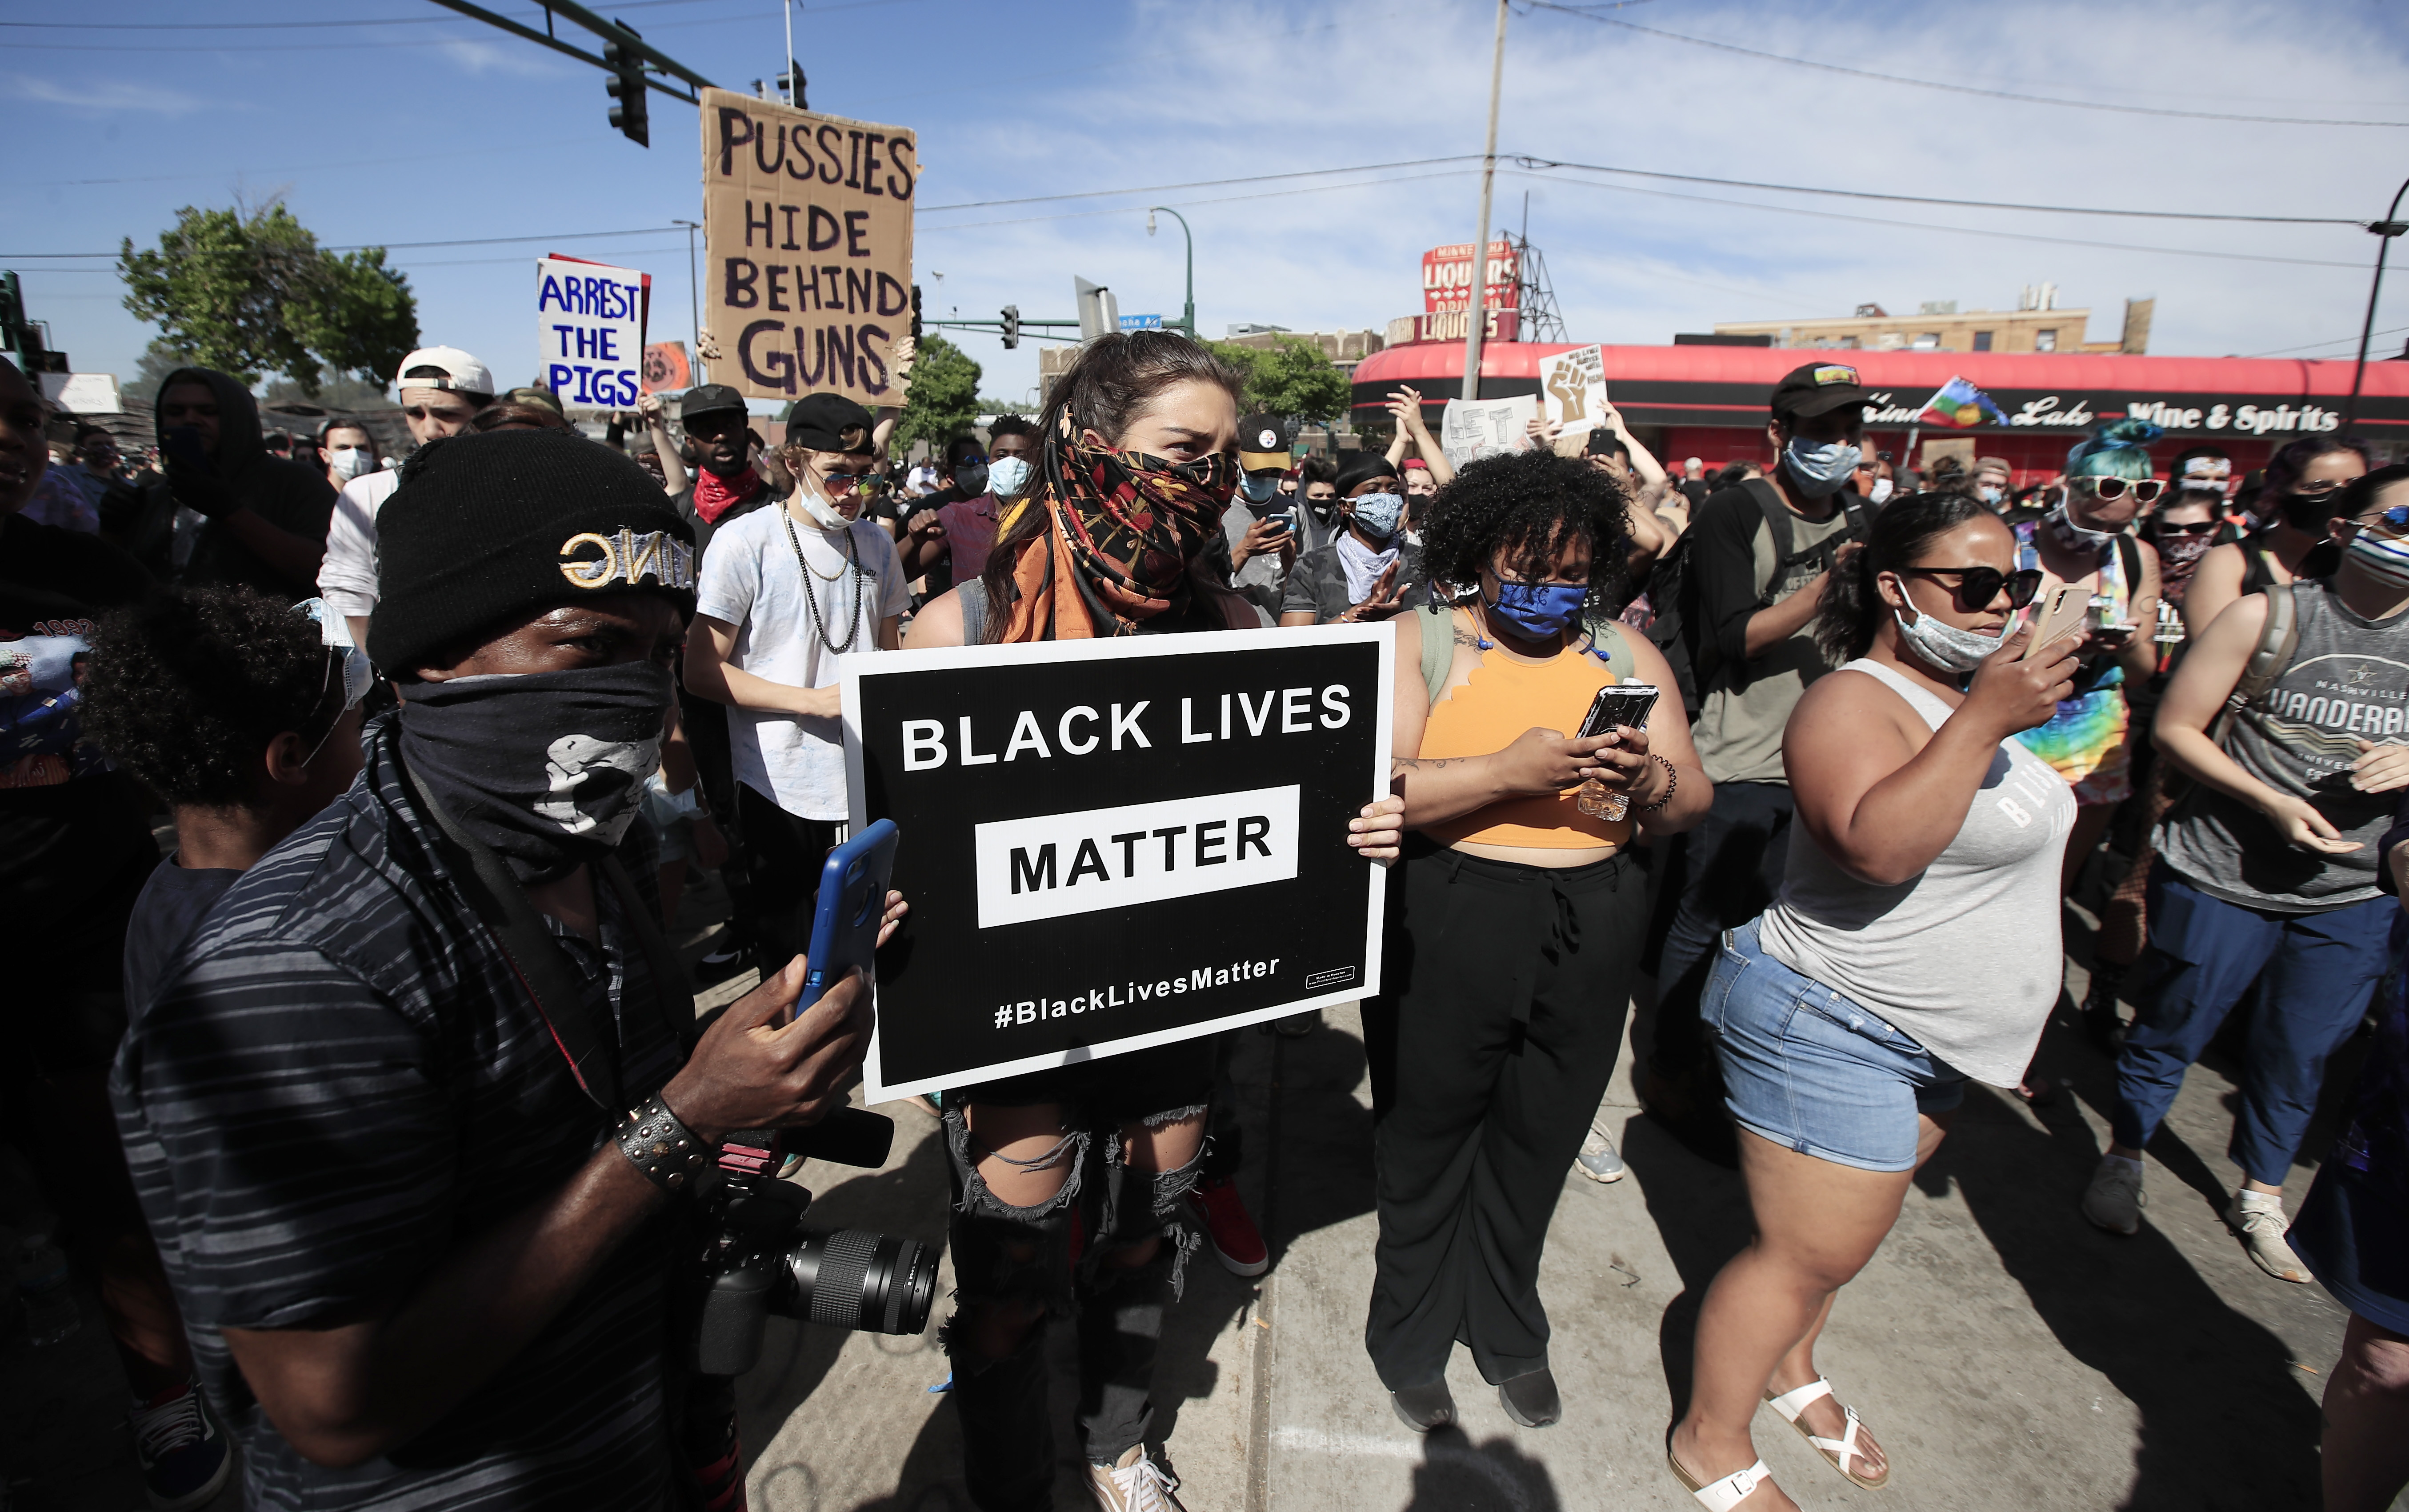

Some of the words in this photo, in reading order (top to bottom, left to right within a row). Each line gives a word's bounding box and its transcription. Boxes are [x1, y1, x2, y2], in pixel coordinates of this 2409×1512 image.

[719, 107, 915, 201] PUSSIES
[745, 200, 870, 257] HIDE
[725, 258, 908, 316] BEHIND
[1424, 256, 1516, 290] LIQURS
[539, 275, 639, 321] ARREST
[552, 325, 619, 360] THE
[1420, 311, 1498, 342] LIQUOS
[737, 320, 892, 396] GUNS
[550, 364, 637, 407] PIGS
[1449, 407, 1513, 444] LET
[2010, 396, 2093, 427] Lake
[2128, 401, 2203, 429] Wine
[2205, 404, 2232, 430] &
[2234, 404, 2339, 435] Spirits
[32, 618, 95, 638] 1992
[2315, 680, 2408, 700] NASHVILLE
[902, 700, 1152, 772] BLACK
[1181, 684, 1351, 744] LIVES
[1996, 760, 2062, 828] BLISS
[1010, 816, 1272, 895] MATTER
[995, 958, 1280, 1029] #BlackLivesMatter
